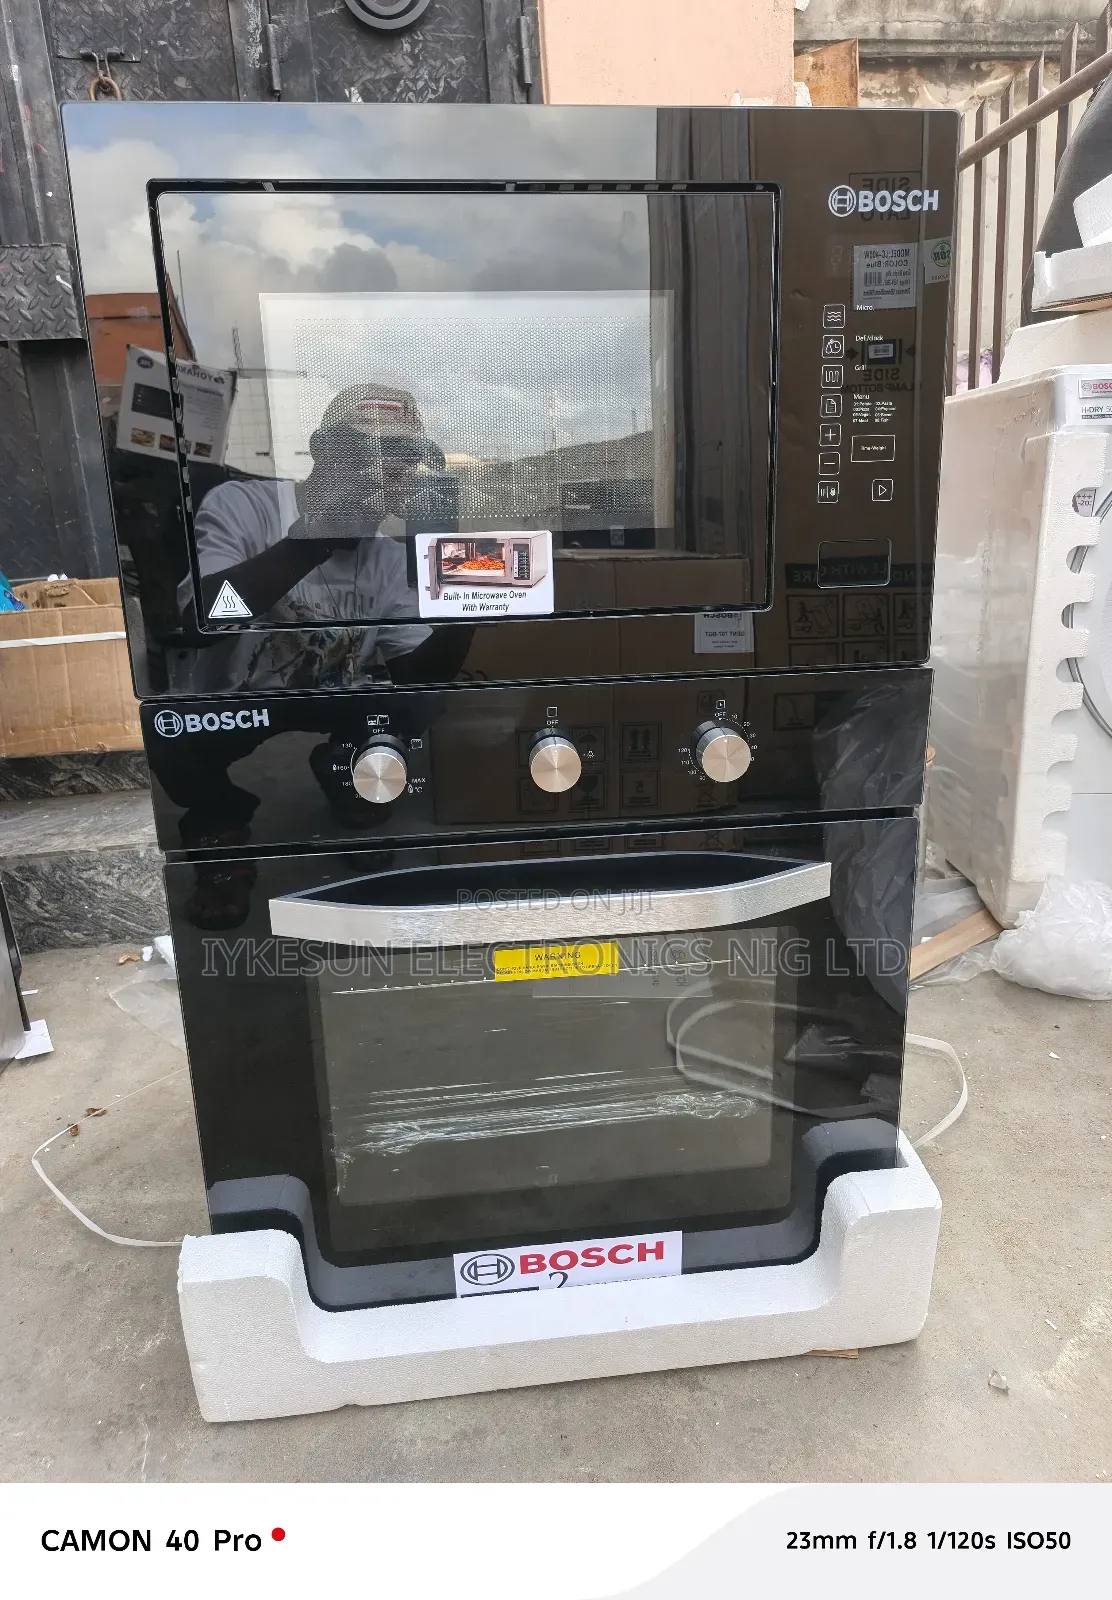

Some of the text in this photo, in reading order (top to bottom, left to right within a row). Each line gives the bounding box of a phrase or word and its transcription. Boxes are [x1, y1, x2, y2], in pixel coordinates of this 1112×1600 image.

[858, 190, 939, 212] BOSCH
[463, 592, 470, 600] In
[471, 591, 507, 600] Microwave
[509, 590, 527, 599] Oven
[462, 603, 509, 612] With Warranty
[185, 709, 270, 733] BOSCH
[534, 951, 581, 961] WARNING
[519, 1240, 665, 1275] BOSCH
